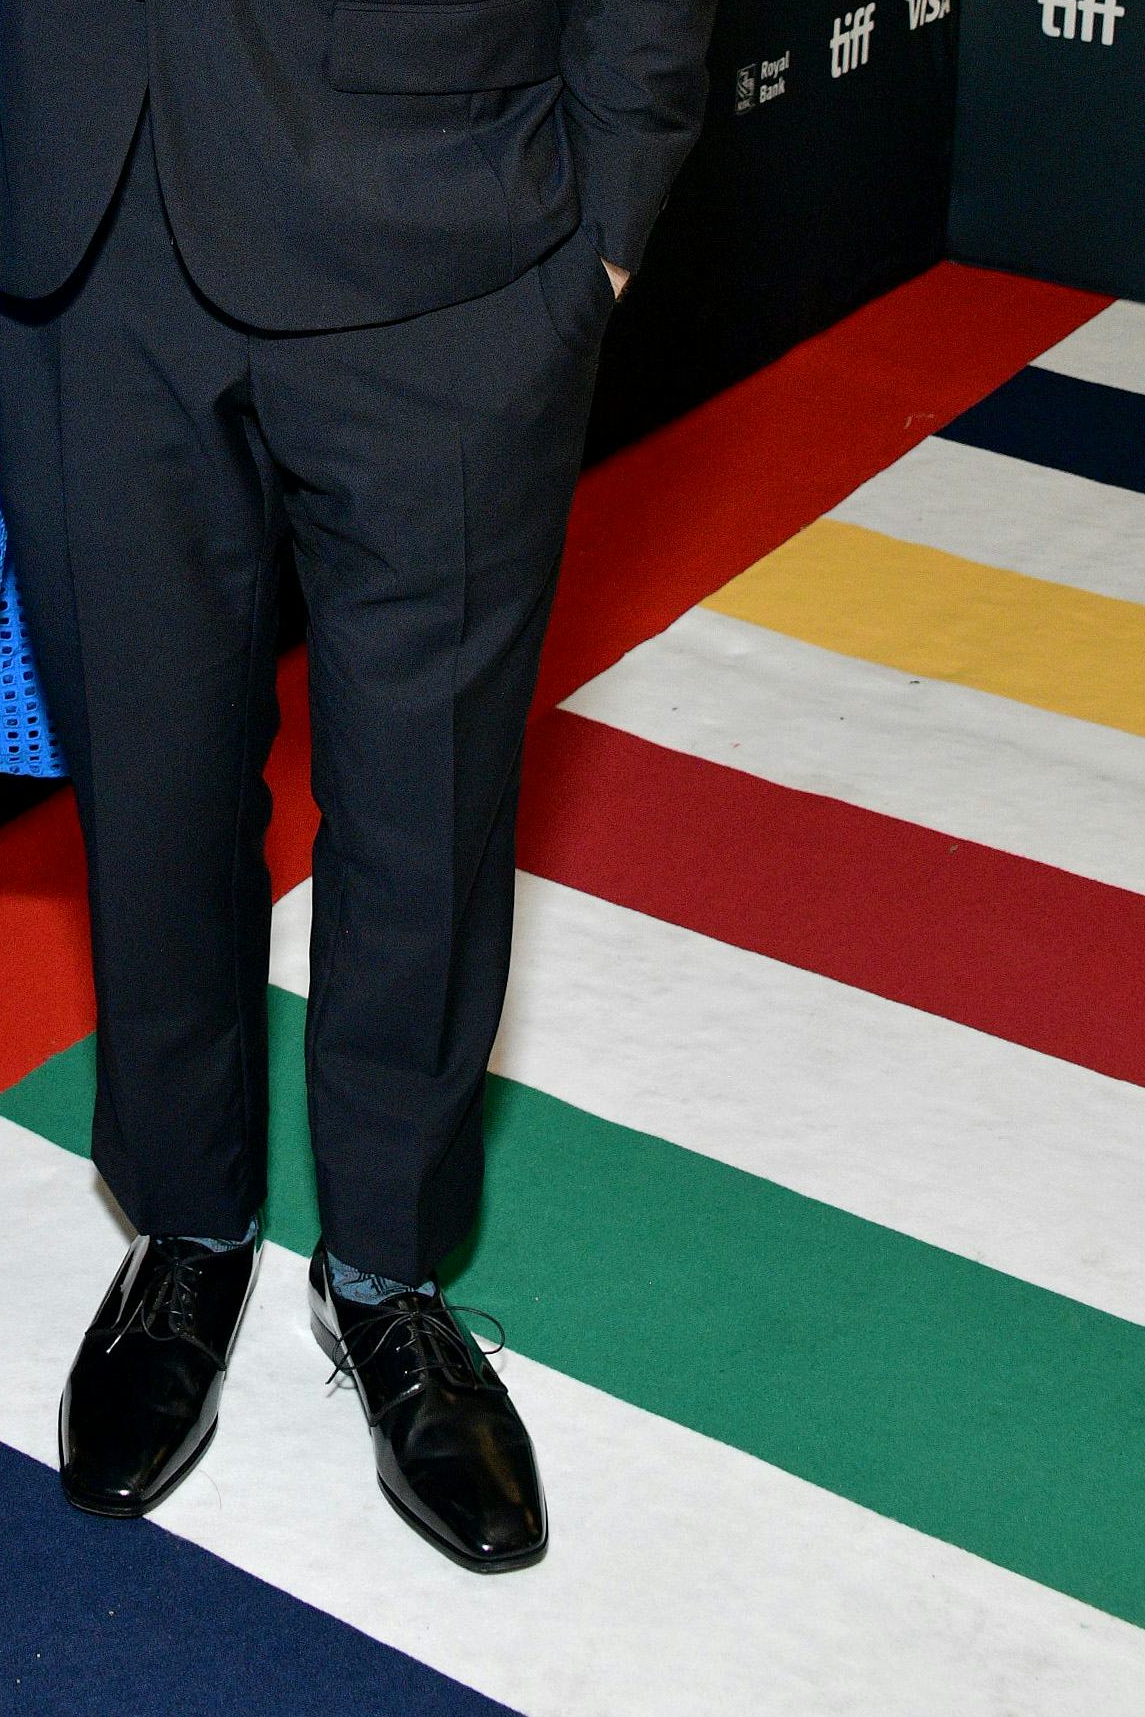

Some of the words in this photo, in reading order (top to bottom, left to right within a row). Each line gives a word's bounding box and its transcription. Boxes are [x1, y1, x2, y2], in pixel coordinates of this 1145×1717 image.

[830, 3, 875, 78] tiff
[761, 51, 790, 80] Royal
[760, 76, 785, 103] Bank
